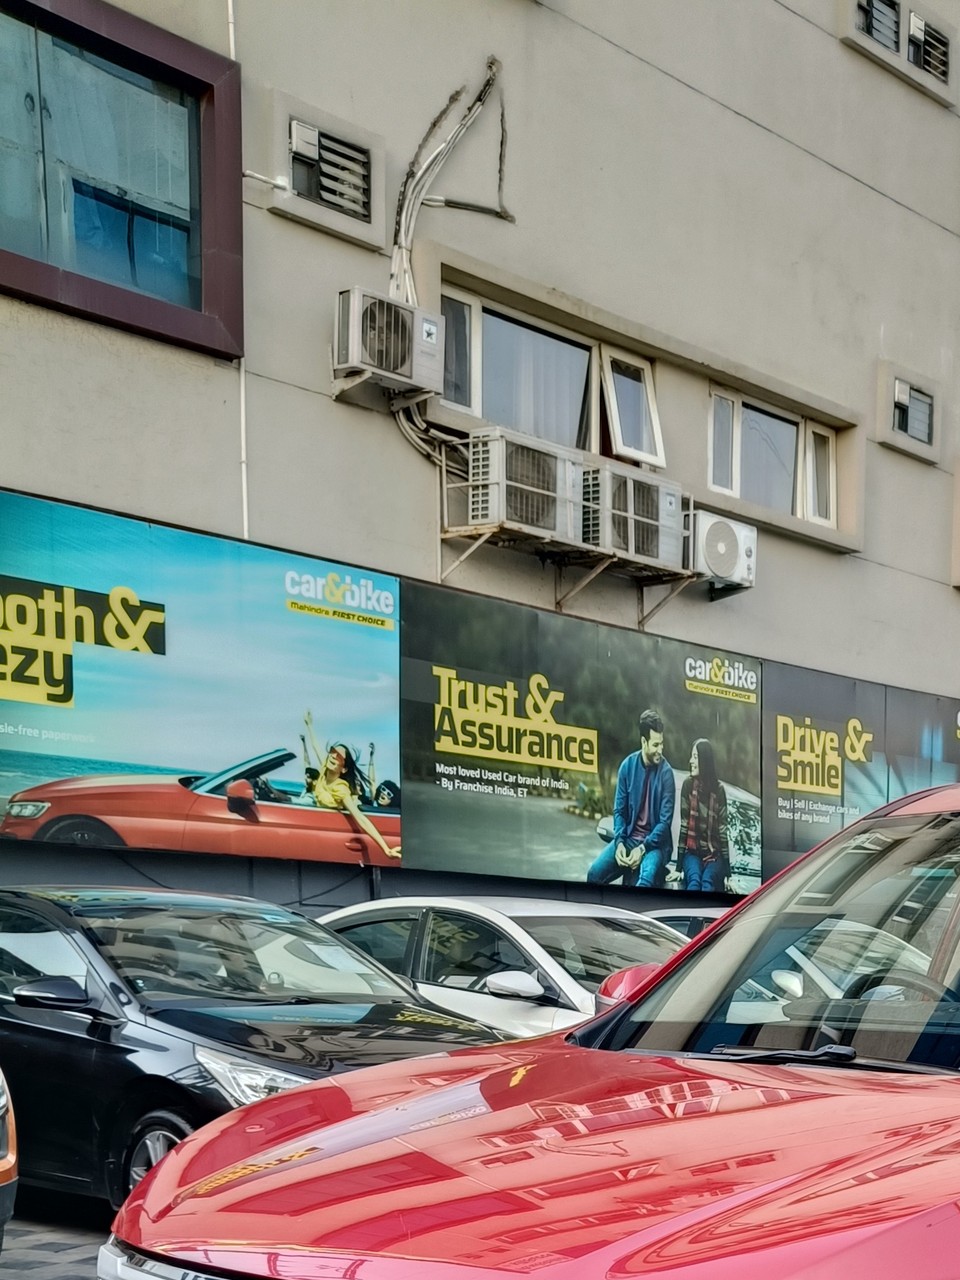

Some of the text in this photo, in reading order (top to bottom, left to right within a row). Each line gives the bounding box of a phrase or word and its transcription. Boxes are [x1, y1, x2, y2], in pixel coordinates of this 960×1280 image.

[285, 571, 394, 614] car&bike
[0, 586, 165, 654] oth &
[331, 609, 356, 621] FIRST
[356, 614, 386, 627] CHOICE
[0, 643, 73, 704] zy
[685, 657, 757, 690] car&bike
[432, 665, 565, 724] Trust &
[435, 706, 595, 766] Assurance
[777, 715, 873, 762] Drive &
[435, 763, 569, 790] Most loved Used Car brand of India
[441, 778, 453, 791] By
[455, 780, 493, 793] Franchise
[495, 785, 516, 798] India,
[518, 787, 528, 798] ET
[777, 749, 840, 789] Smile
[778, 797, 790, 809] Buy
[794, 799, 805, 809] Sell
[809, 801, 835, 814] Exchange
[778, 809, 830, 823] bikes of any brand
